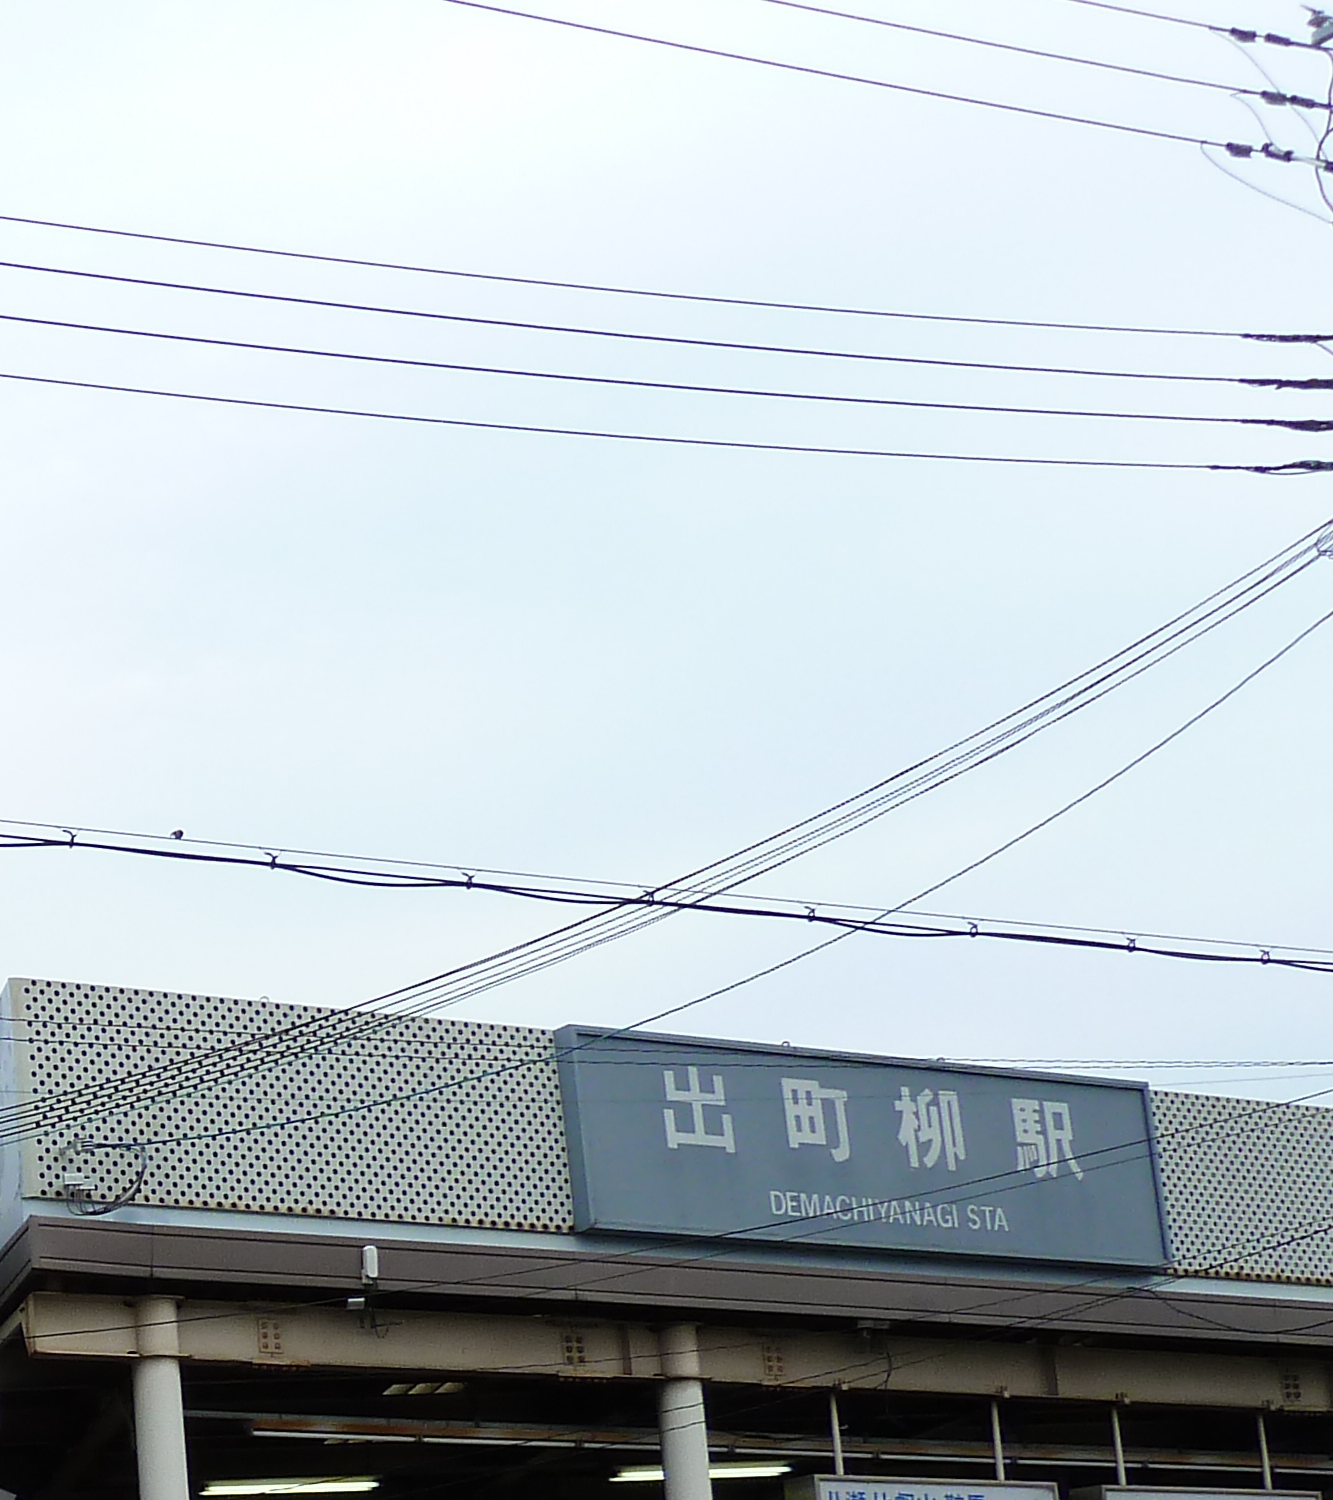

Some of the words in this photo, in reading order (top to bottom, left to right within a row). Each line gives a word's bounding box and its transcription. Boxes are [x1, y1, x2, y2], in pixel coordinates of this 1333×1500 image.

[663, 1065, 1083, 1180] 出町柳駅
[769, 1189, 960, 1229] DEMACHIYANAGI
[967, 1207, 1009, 1232] STA
